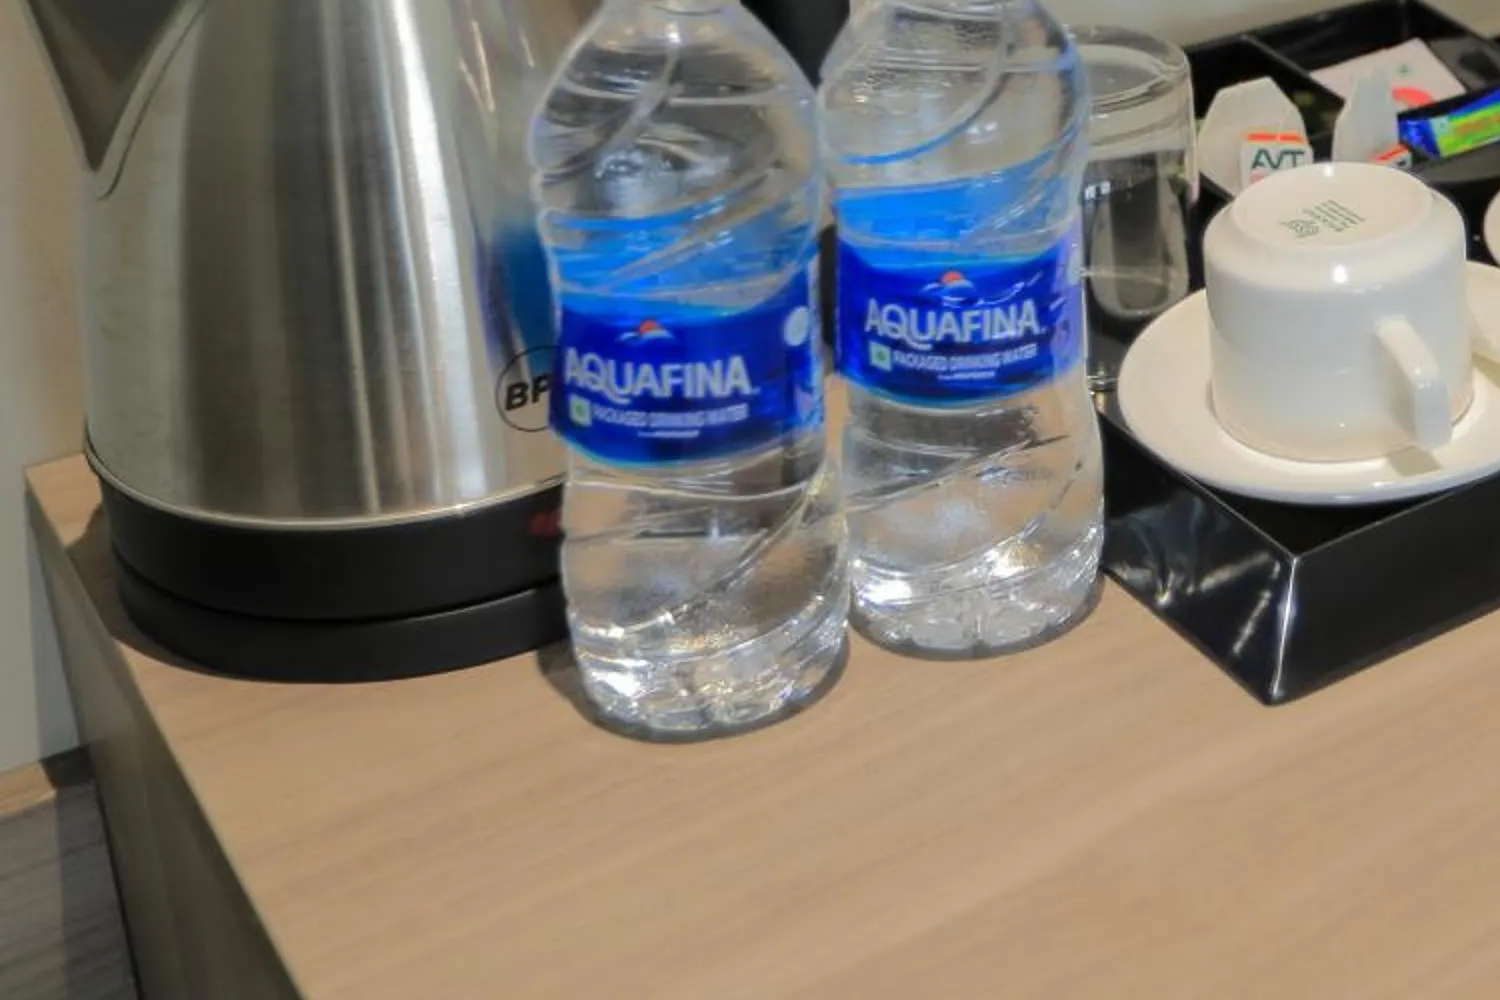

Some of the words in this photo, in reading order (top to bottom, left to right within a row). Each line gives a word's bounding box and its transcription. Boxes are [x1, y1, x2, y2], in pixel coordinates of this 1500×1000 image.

[1250, 148, 1306, 170] AVT
[863, 297, 1041, 351] AQUAFINA
[505, 373, 552, 411] BP
[563, 346, 752, 404] AQUAFINA
